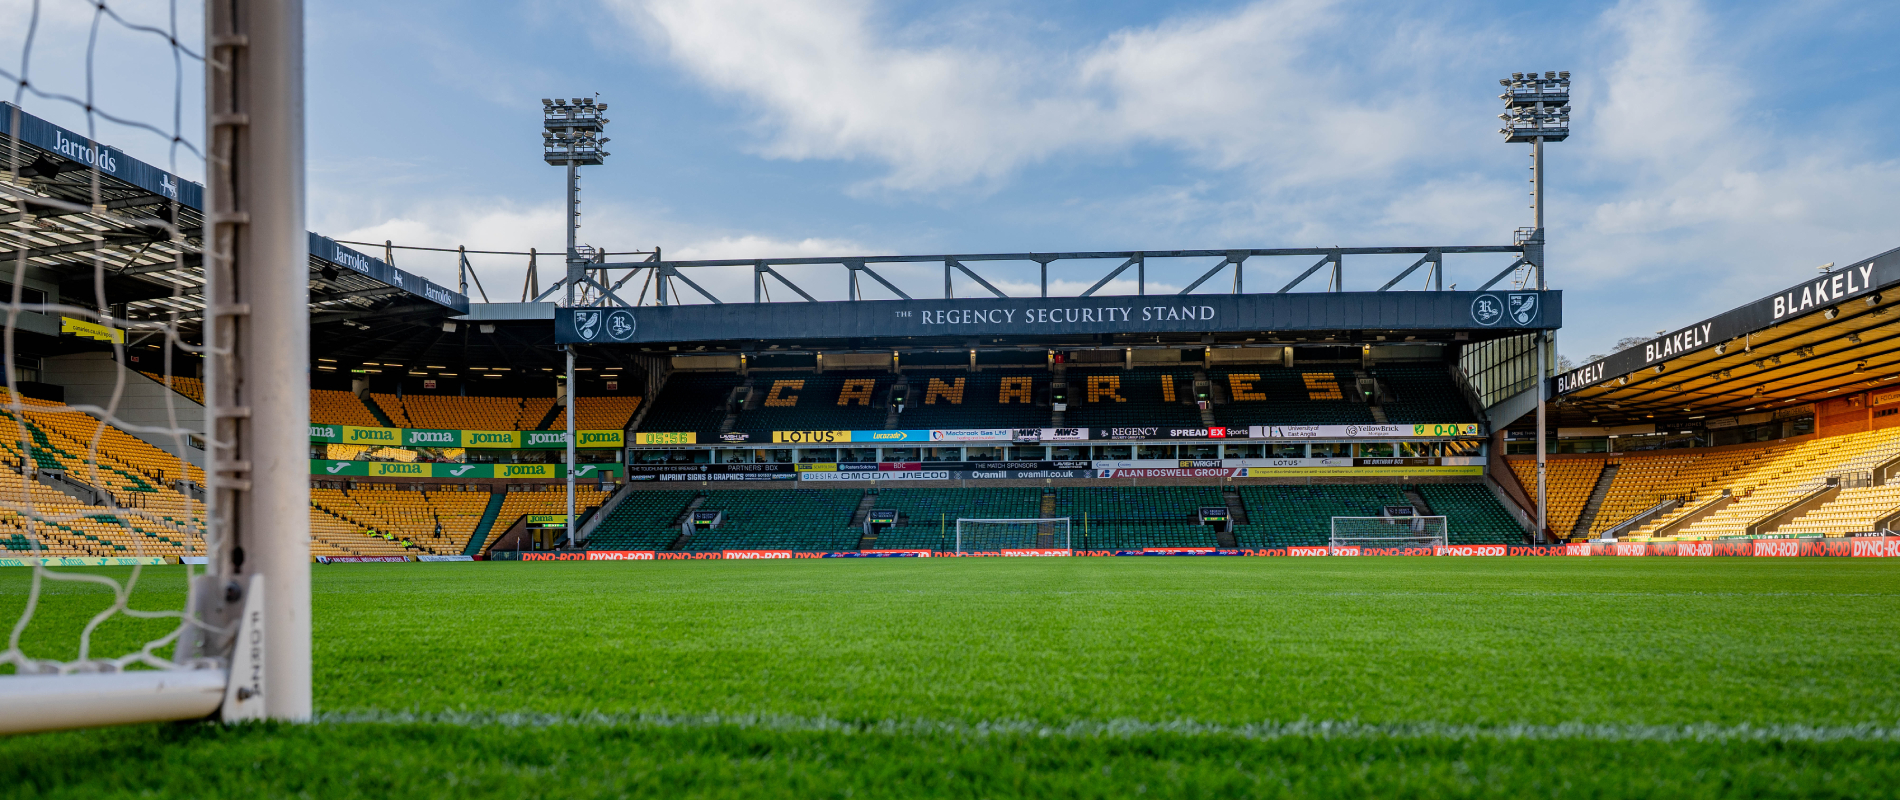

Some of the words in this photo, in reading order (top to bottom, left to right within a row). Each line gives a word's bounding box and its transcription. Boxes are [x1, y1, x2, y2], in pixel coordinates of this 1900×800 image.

[53, 130, 116, 173] Jarrolds
[335, 246, 369, 273] Jarrolds
[425, 283, 452, 306] Jarrolds
[1773, 262, 1874, 319] BLAKELY
[922, 308, 1016, 325] REGENCY
[1025, 307, 1133, 323] SECURITY
[1142, 305, 1215, 321] STAND
[1646, 322, 1712, 363] BLAKELY
[1558, 361, 1605, 394] BLAKELY
[308, 427, 335, 438] oma
[350, 429, 394, 441] Joma
[873, 431, 901, 440] Lucozade
[1018, 428, 1042, 437] MWS
[1054, 428, 1079, 436] MWS
[1111, 427, 1159, 436] REGENCY
[1226, 428, 1248, 437] Sports
[1434, 424, 1457, 436] 0-0
[408, 431, 454, 443] Joma
[469, 433, 513, 445] Joma
[579, 432, 622, 445] Joma
[645, 432, 688, 444] 05:56
[780, 430, 835, 443] LOTUS
[378, 463, 422, 475] Joma
[1179, 460, 1221, 468] BETWRIGHT
[503, 465, 546, 477] Joma
[659, 473, 686, 481] IMPRINT
[687, 473, 706, 481] SIGNS
[713, 473, 744, 481] GRAPHICS
[972, 471, 1007, 479] Ovamill
[1017, 470, 1074, 479] ovamill.co.uk
[1117, 469, 1144, 477] ALAN
[1146, 469, 1194, 477] BOSWELL
[1194, 468, 1229, 477] GROUP
[1363, 547, 1432, 557] DYNO-ROD
[1435, 546, 1505, 557] DYNO-ROD
[1567, 545, 1590, 556] DYNO-ROD
[1591, 544, 1617, 556] DYNO-ROD
[1618, 544, 1645, 557] DYNO-ROD
[1646, 544, 1677, 557] DYNO-ROD
[1678, 543, 1712, 557] DYNO-ROD
[1714, 543, 1753, 557] DYNO-ROD
[1755, 541, 1798, 557] DYNO-ROD
[1800, 541, 1850, 557] DYNO-ROD
[522, 552, 586, 561] DYNO-ROD
[589, 552, 653, 561] DYNO-ROD
[657, 552, 722, 560] DYNO-ROD
[0, 558, 25, 567] oma
